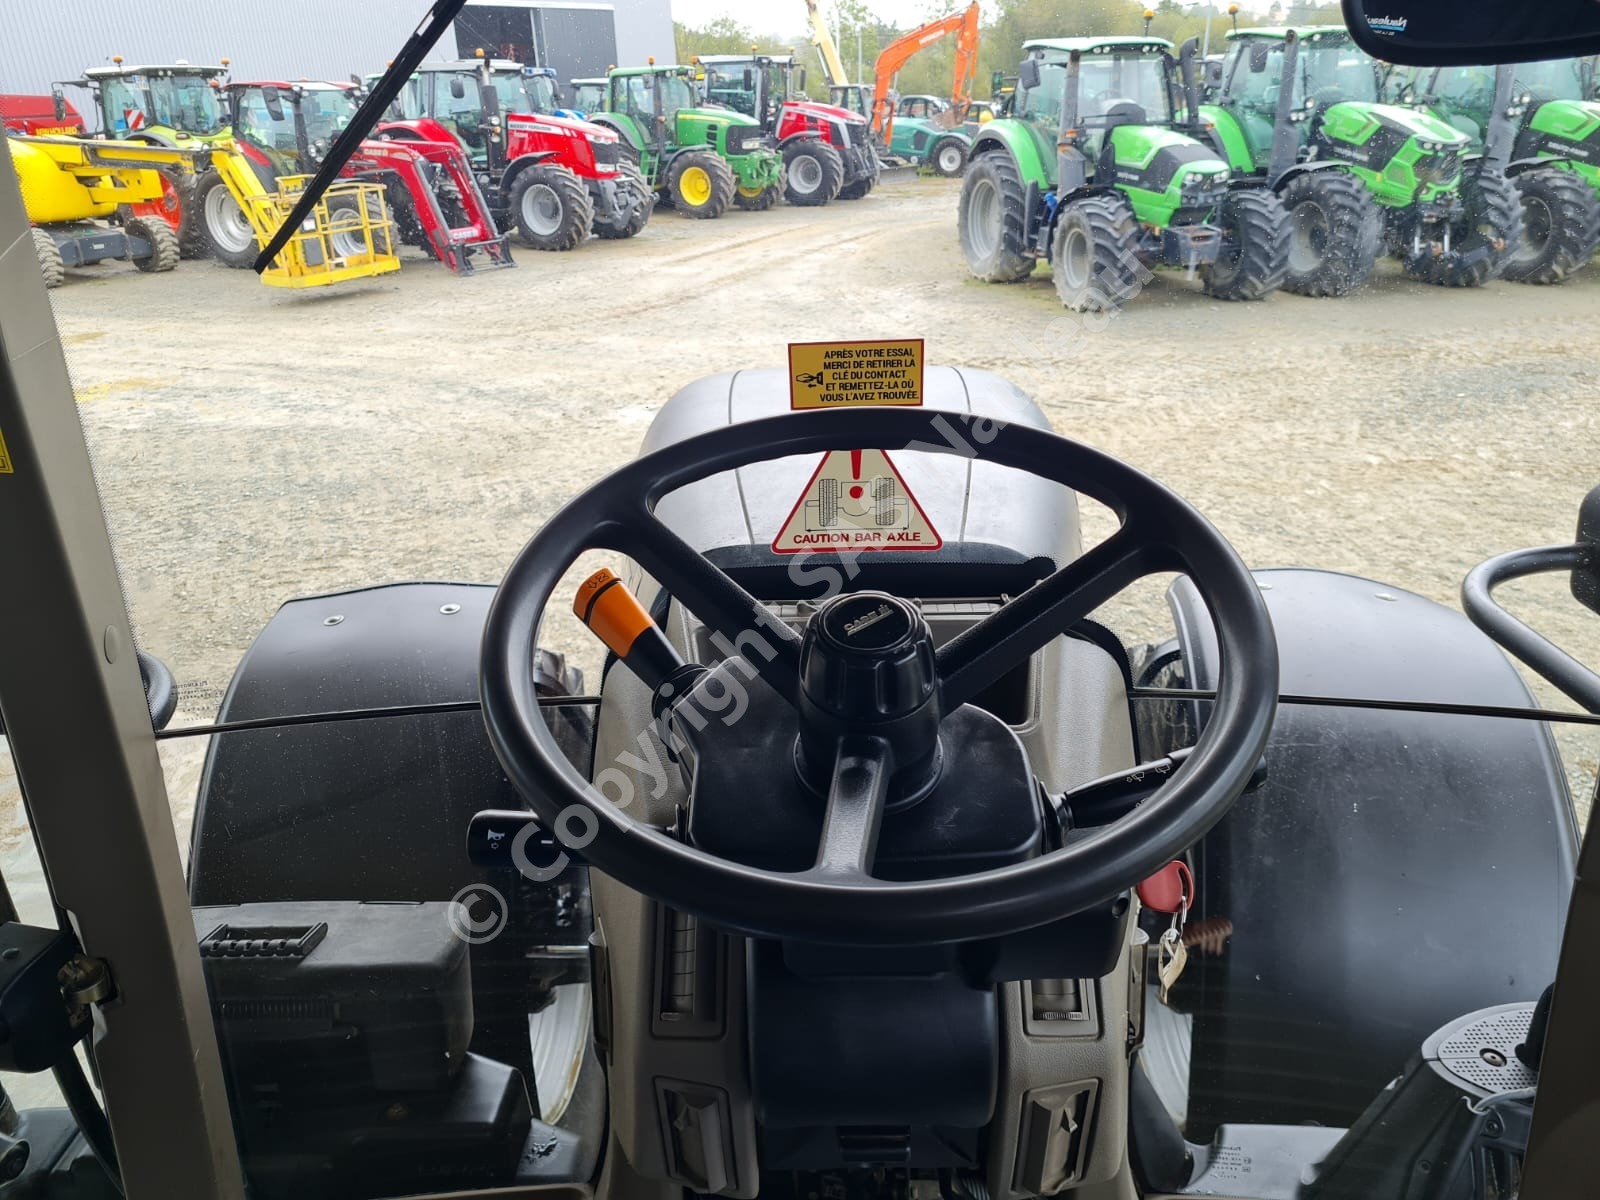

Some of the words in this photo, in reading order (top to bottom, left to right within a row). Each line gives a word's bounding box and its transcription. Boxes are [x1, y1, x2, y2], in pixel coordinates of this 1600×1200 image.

[824, 348, 853, 359] APRÈS
[855, 348, 885, 358] VOTRE
[886, 348, 915, 357] ESSAI,
[823, 360, 851, 370] MERCI
[853, 360, 864, 369] DE
[866, 359, 903, 369] RETIRER
[904, 358, 916, 368] LA
[832, 370, 849, 381] CLÉ
[850, 371, 863, 380] DU
[864, 369, 907, 380] CONTACT
[825, 382, 837, 391] ET
[838, 380, 899, 391] REMETTEZ-LA
[901, 378, 914, 389] OÙ
[820, 392, 844, 402] VOUS
[845, 391, 876, 401] L'AVEZ
[793, 533, 850, 544] CAUTION
[854, 532, 881, 542] BAR
[887, 532, 921, 542] AXLE
